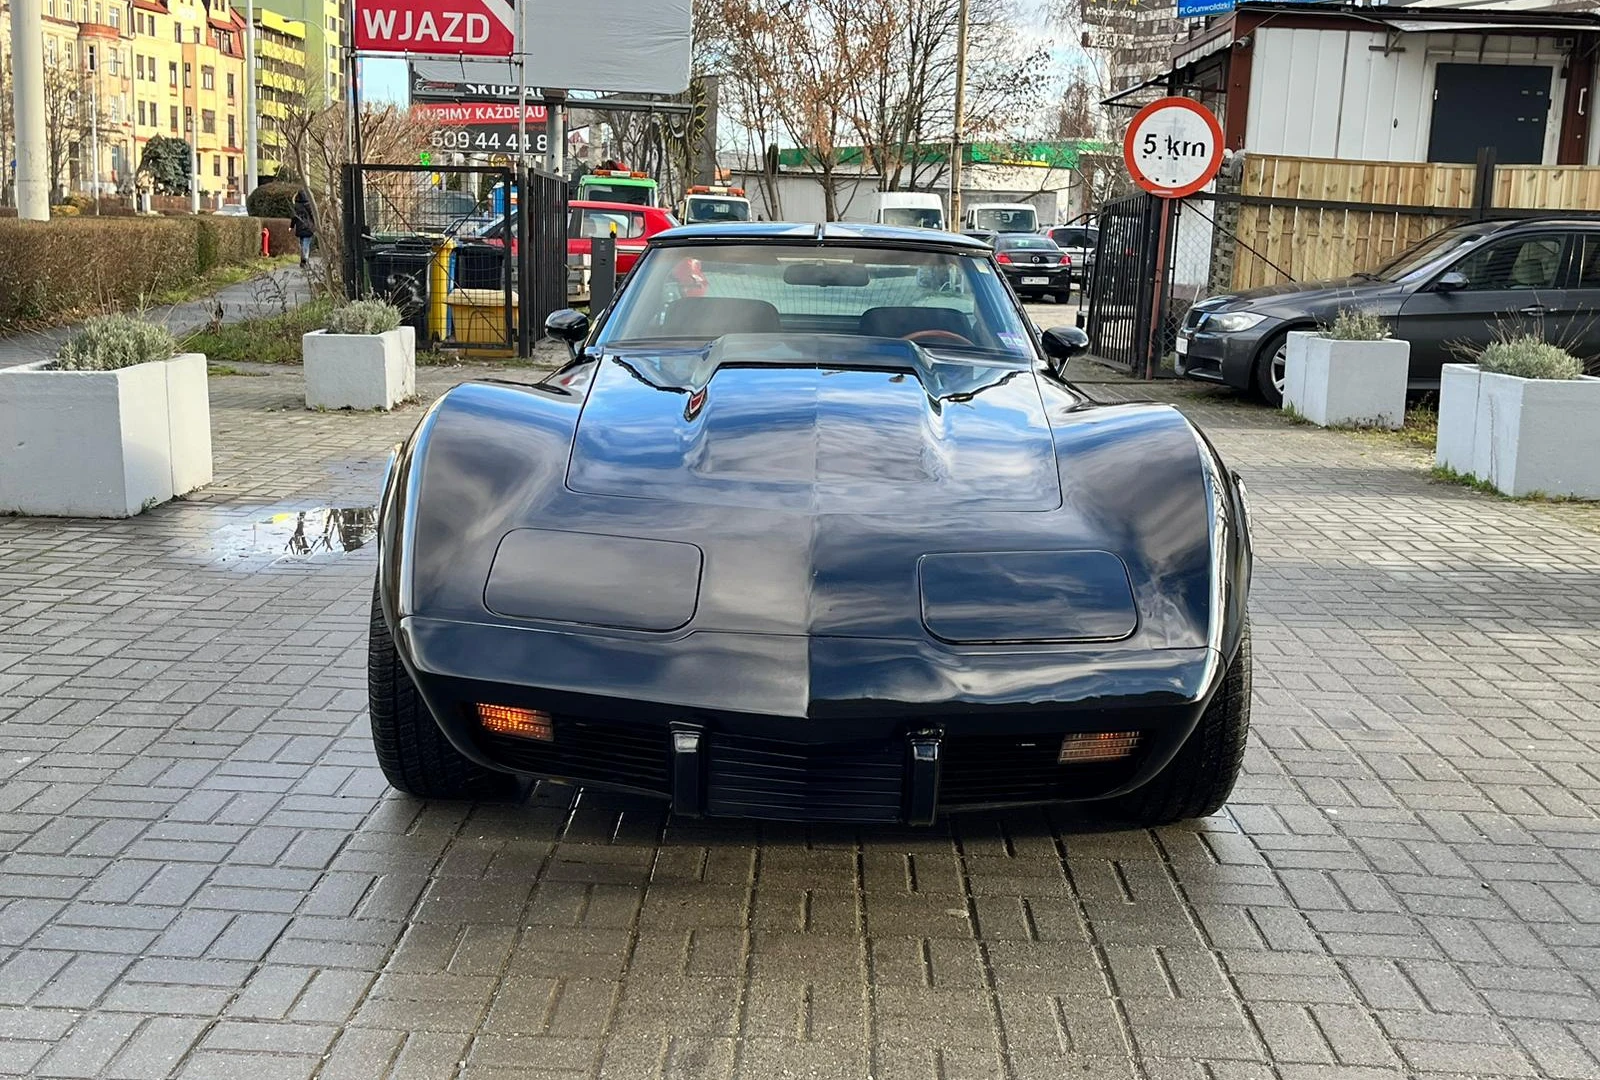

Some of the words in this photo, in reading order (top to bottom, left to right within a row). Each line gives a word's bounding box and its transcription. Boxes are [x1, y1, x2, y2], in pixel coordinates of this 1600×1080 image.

[362, 8, 490, 44] WJAZD
[417, 107, 472, 120] KUPIMY
[475, 104, 521, 119] KAŻDE
[524, 105, 547, 118] AU
[474, 132, 501, 150] 44
[1143, 133, 1157, 155] 5
